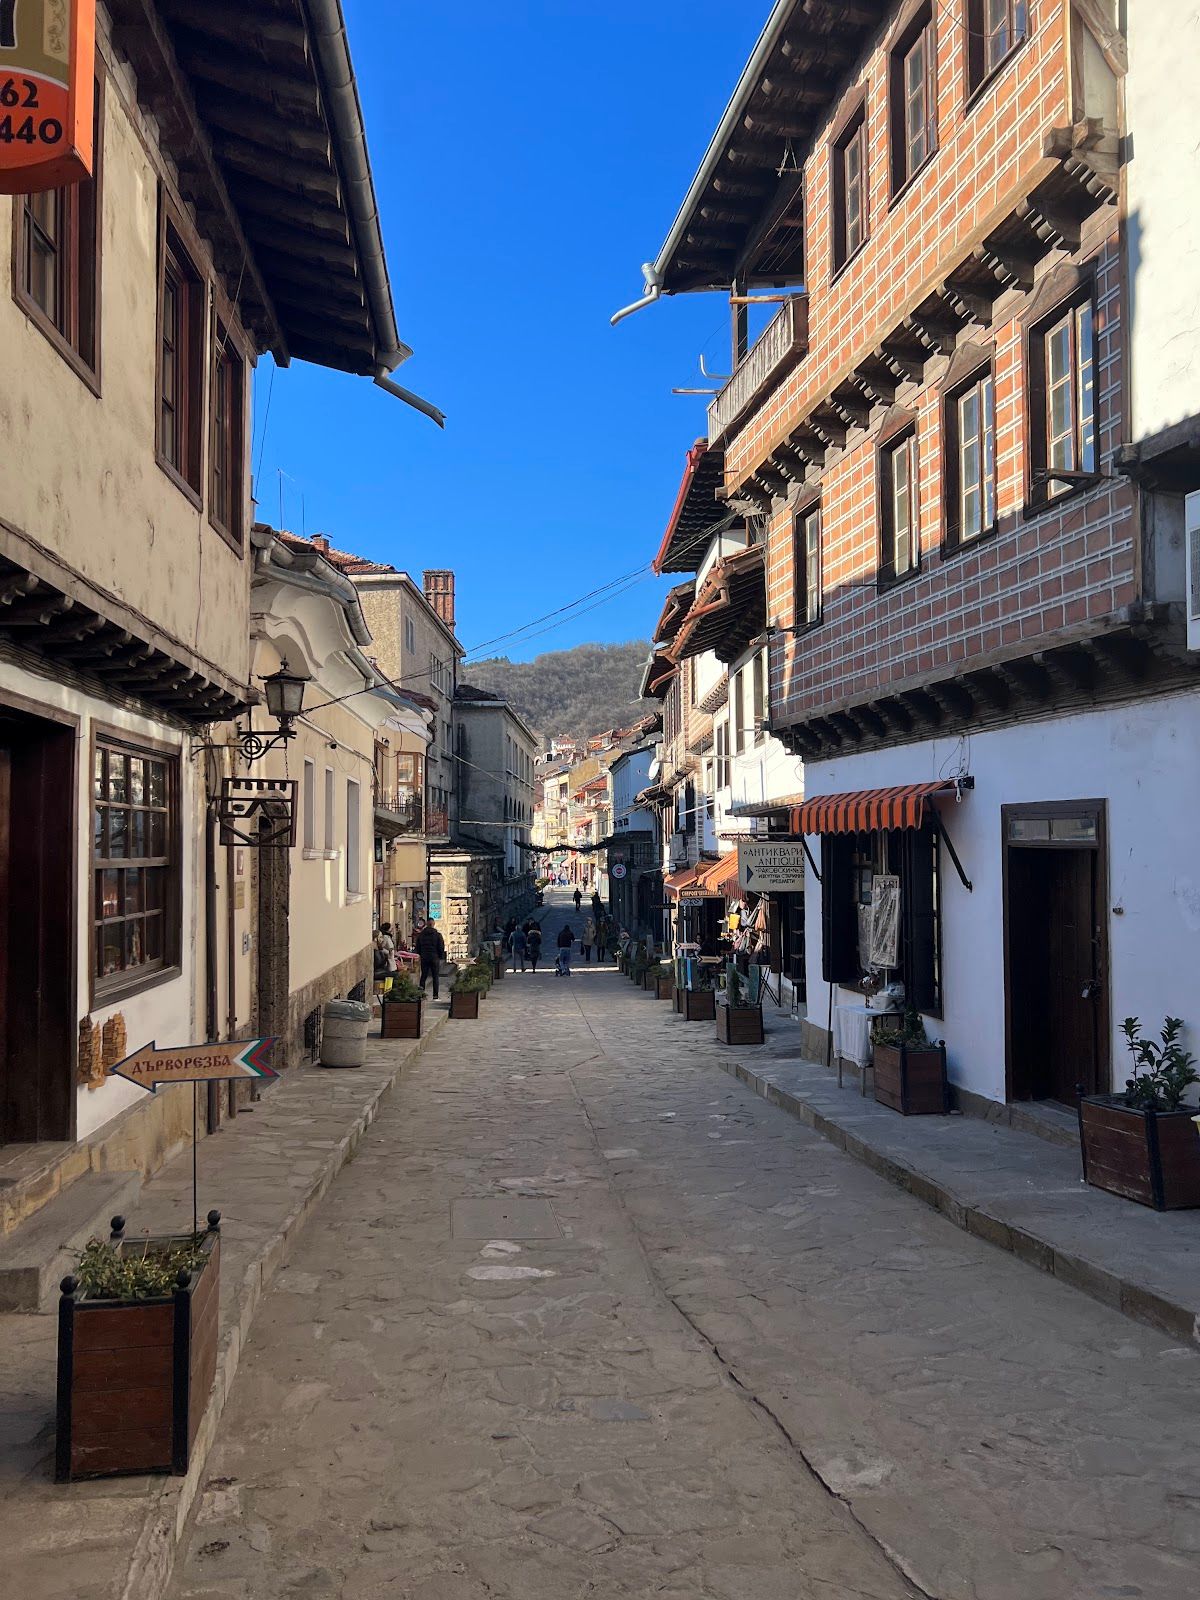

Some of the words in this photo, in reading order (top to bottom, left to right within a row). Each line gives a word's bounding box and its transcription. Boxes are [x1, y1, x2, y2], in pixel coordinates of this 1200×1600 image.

[0, 78, 39, 109] 62
[748, 847, 805, 857] АНТИКВАРИ
[131, 1054, 232, 1075] ДЪРВОРЕЗБА
